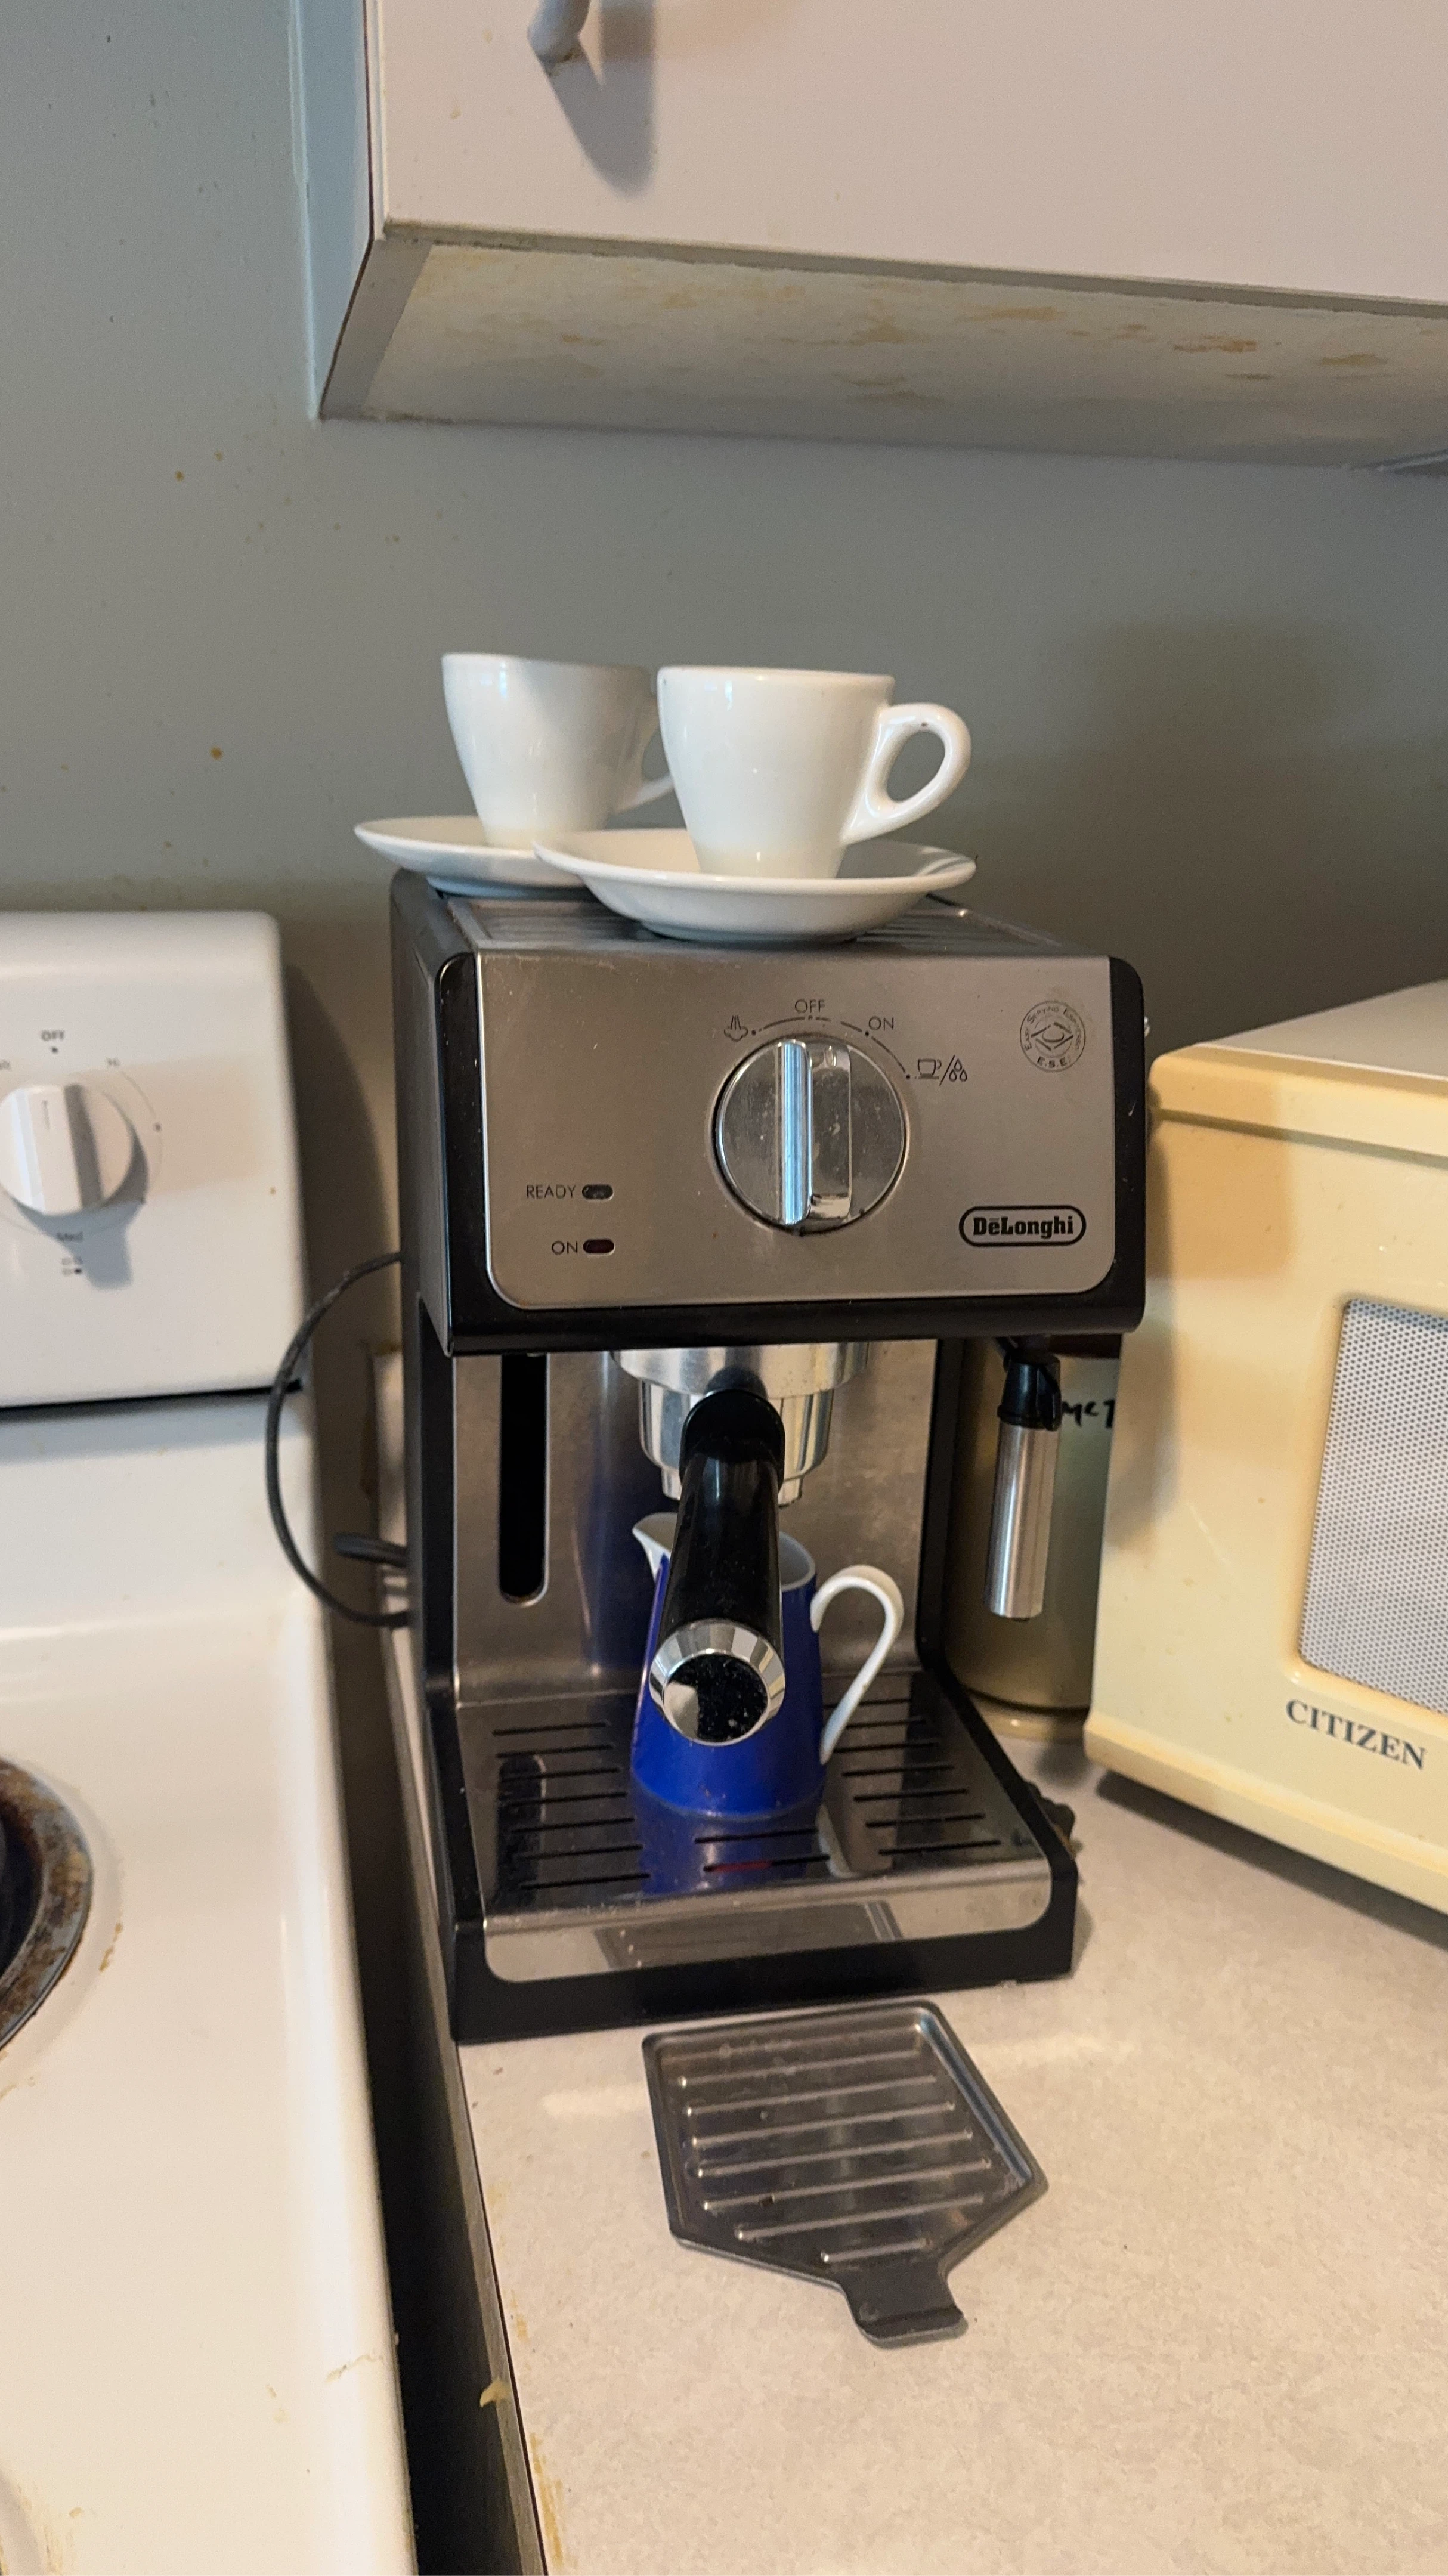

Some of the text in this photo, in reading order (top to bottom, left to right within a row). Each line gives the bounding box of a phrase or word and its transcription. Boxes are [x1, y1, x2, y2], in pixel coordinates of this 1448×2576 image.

[794, 999, 825, 1013] OFF
[868, 1017, 894, 1031] ON
[527, 1184, 576, 1199] READY
[551, 1240, 578, 1255] ON
[1286, 1699, 1425, 1770] CITIZEN
